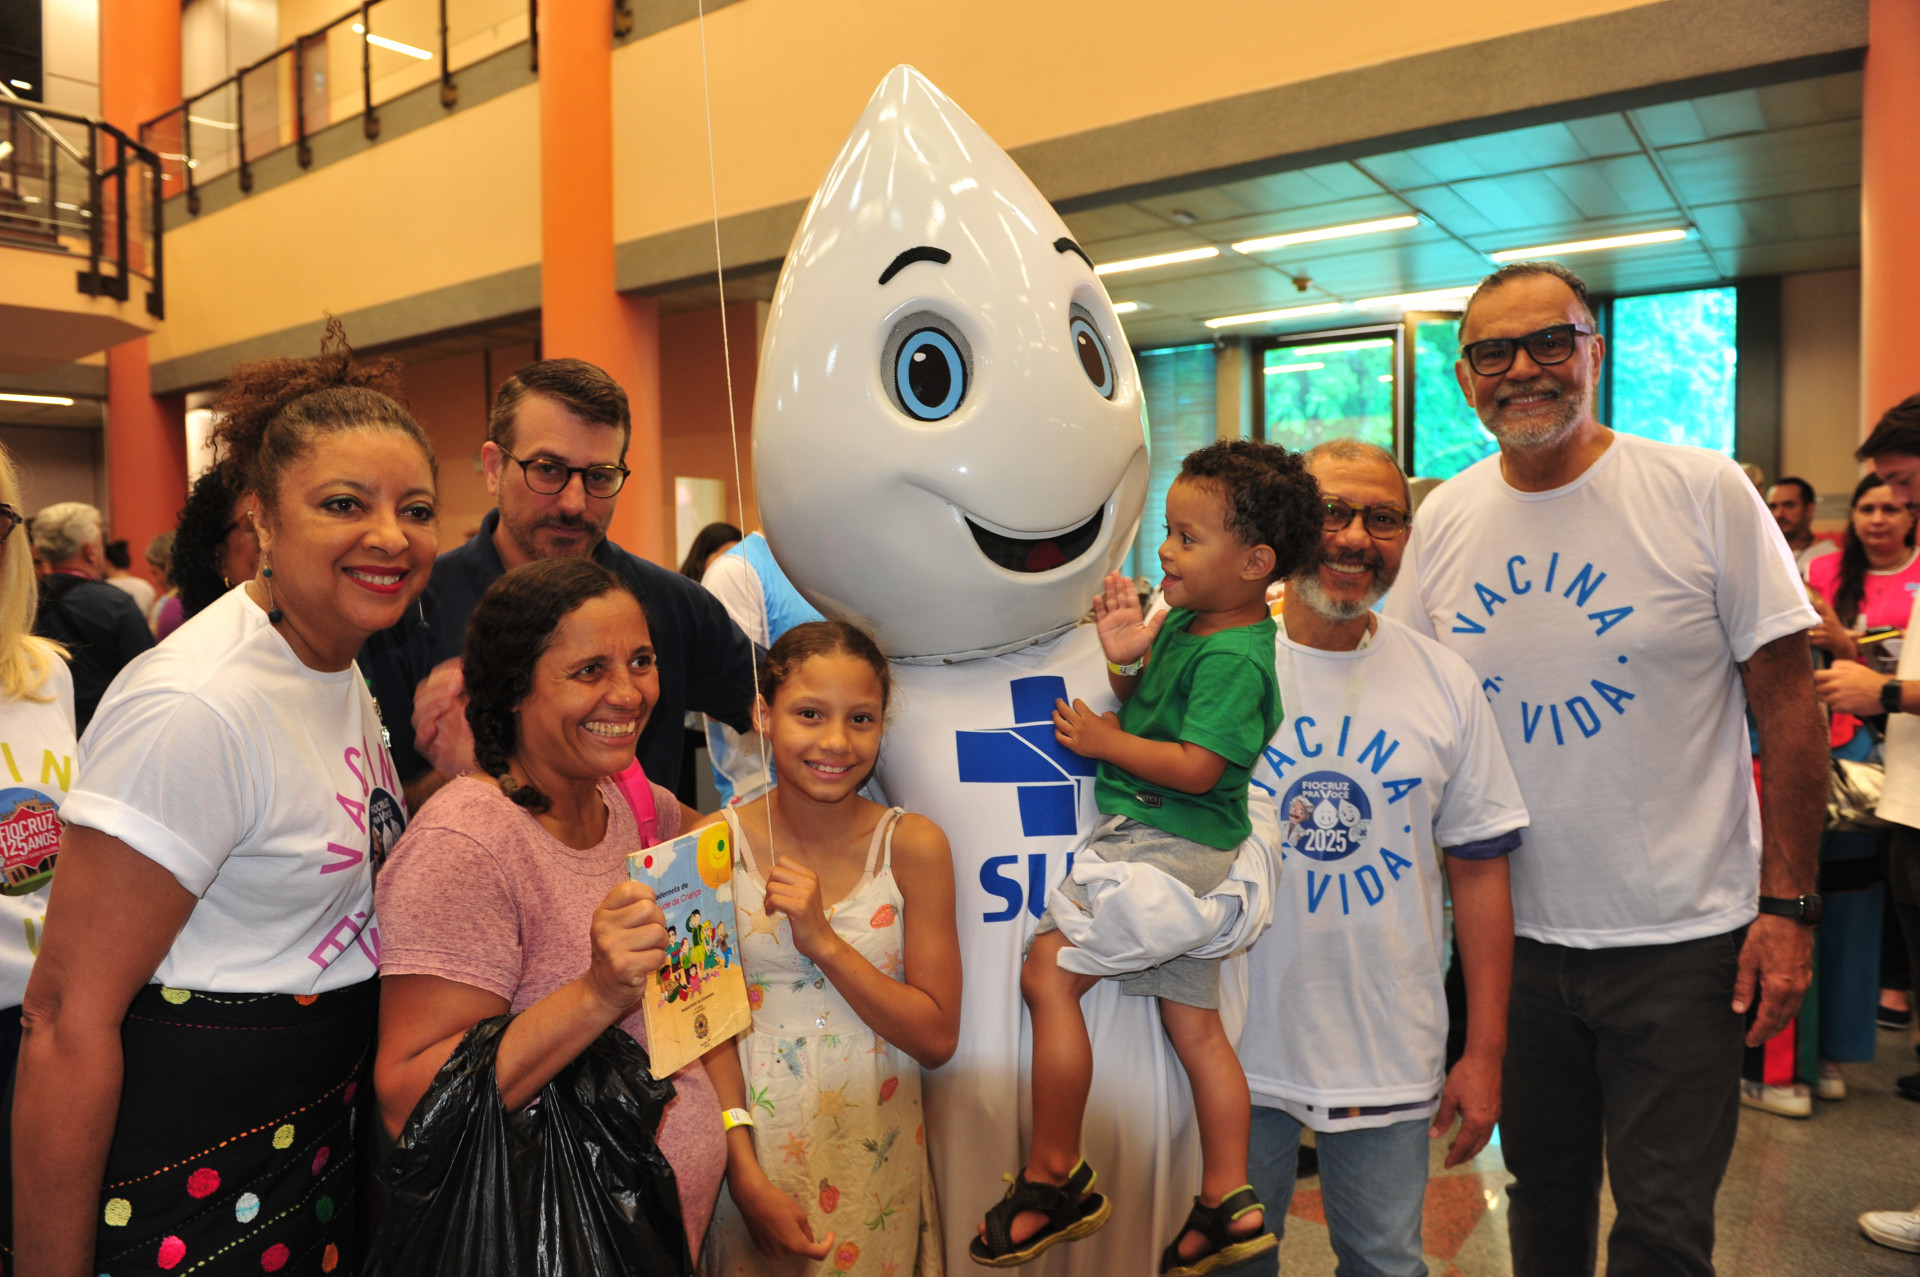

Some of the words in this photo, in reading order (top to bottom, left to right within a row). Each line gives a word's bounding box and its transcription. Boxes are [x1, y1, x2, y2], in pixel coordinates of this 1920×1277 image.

[1451, 551, 1635, 638] VACINA
[1301, 780, 1351, 792] FIOCRUZ
[319, 734, 410, 876] VACIN
[0, 812, 56, 844] FIOCRUZ
[1304, 828, 1348, 853] 2025
[0, 836, 29, 859] 125
[28, 829, 58, 852] ANOS
[656, 885, 681, 901] aderneta
